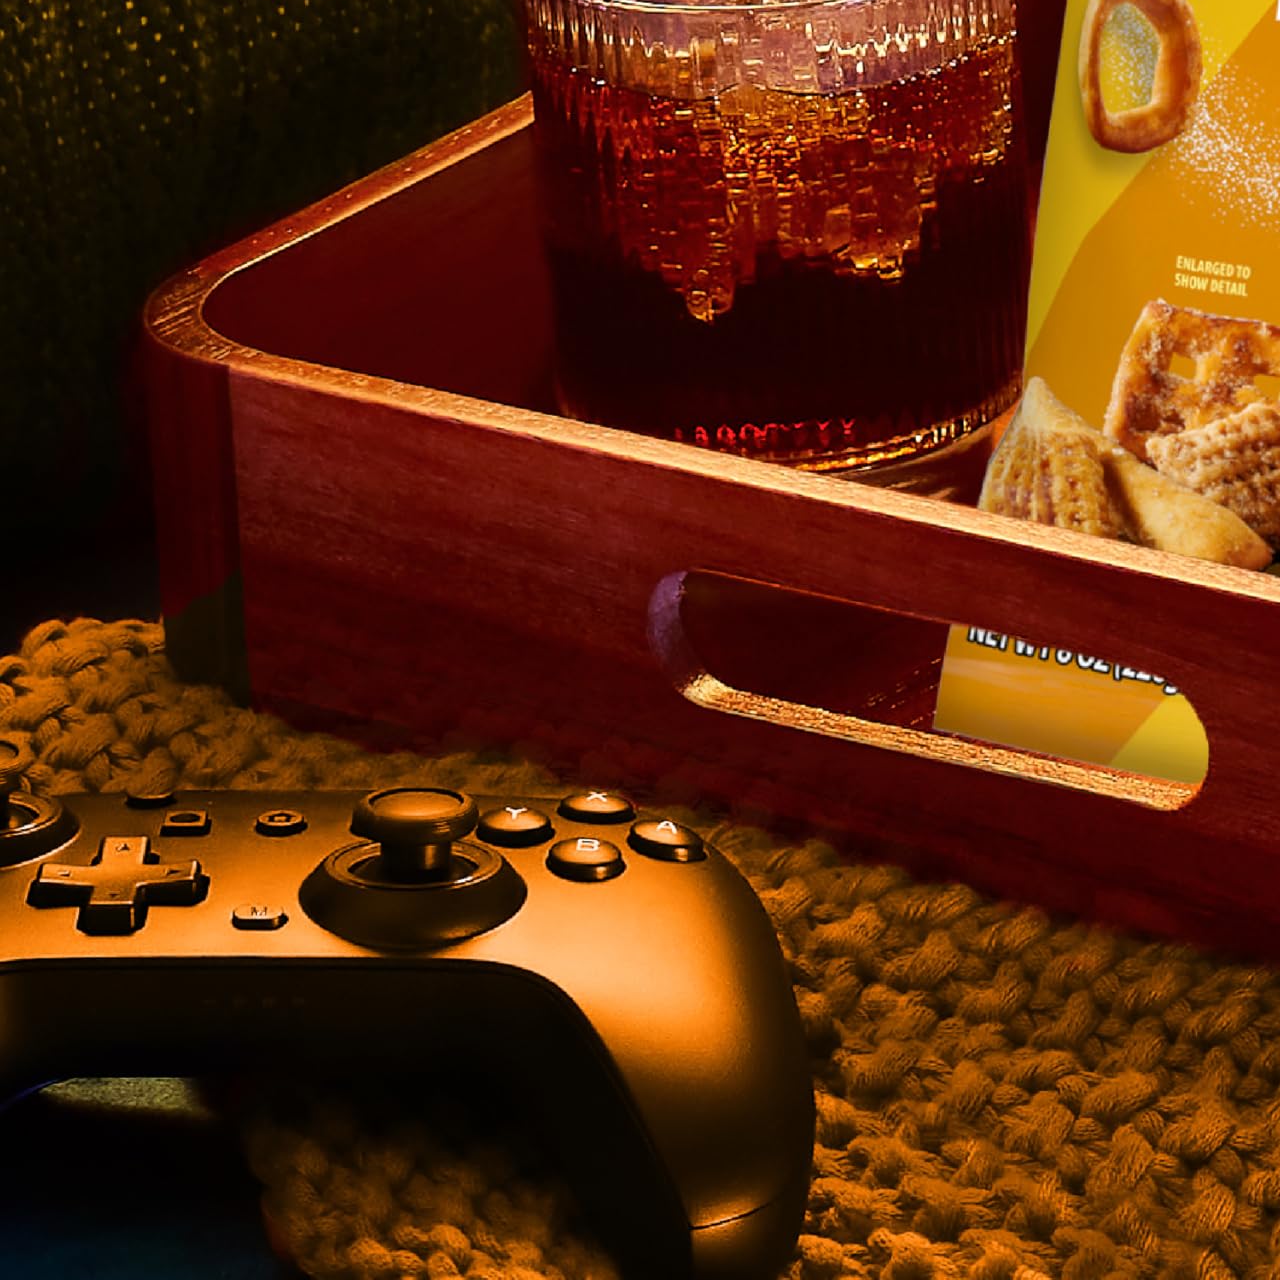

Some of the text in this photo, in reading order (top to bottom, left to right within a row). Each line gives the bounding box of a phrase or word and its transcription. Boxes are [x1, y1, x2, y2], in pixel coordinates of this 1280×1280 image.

[1175, 255, 1252, 280] ENLARGED TO
[1174, 273, 1248, 297] SHOW DETAIL
[586, 791, 608, 803] X
[506, 806, 528, 820] Y
[656, 820, 678, 835] A
[575, 838, 600, 852] B
